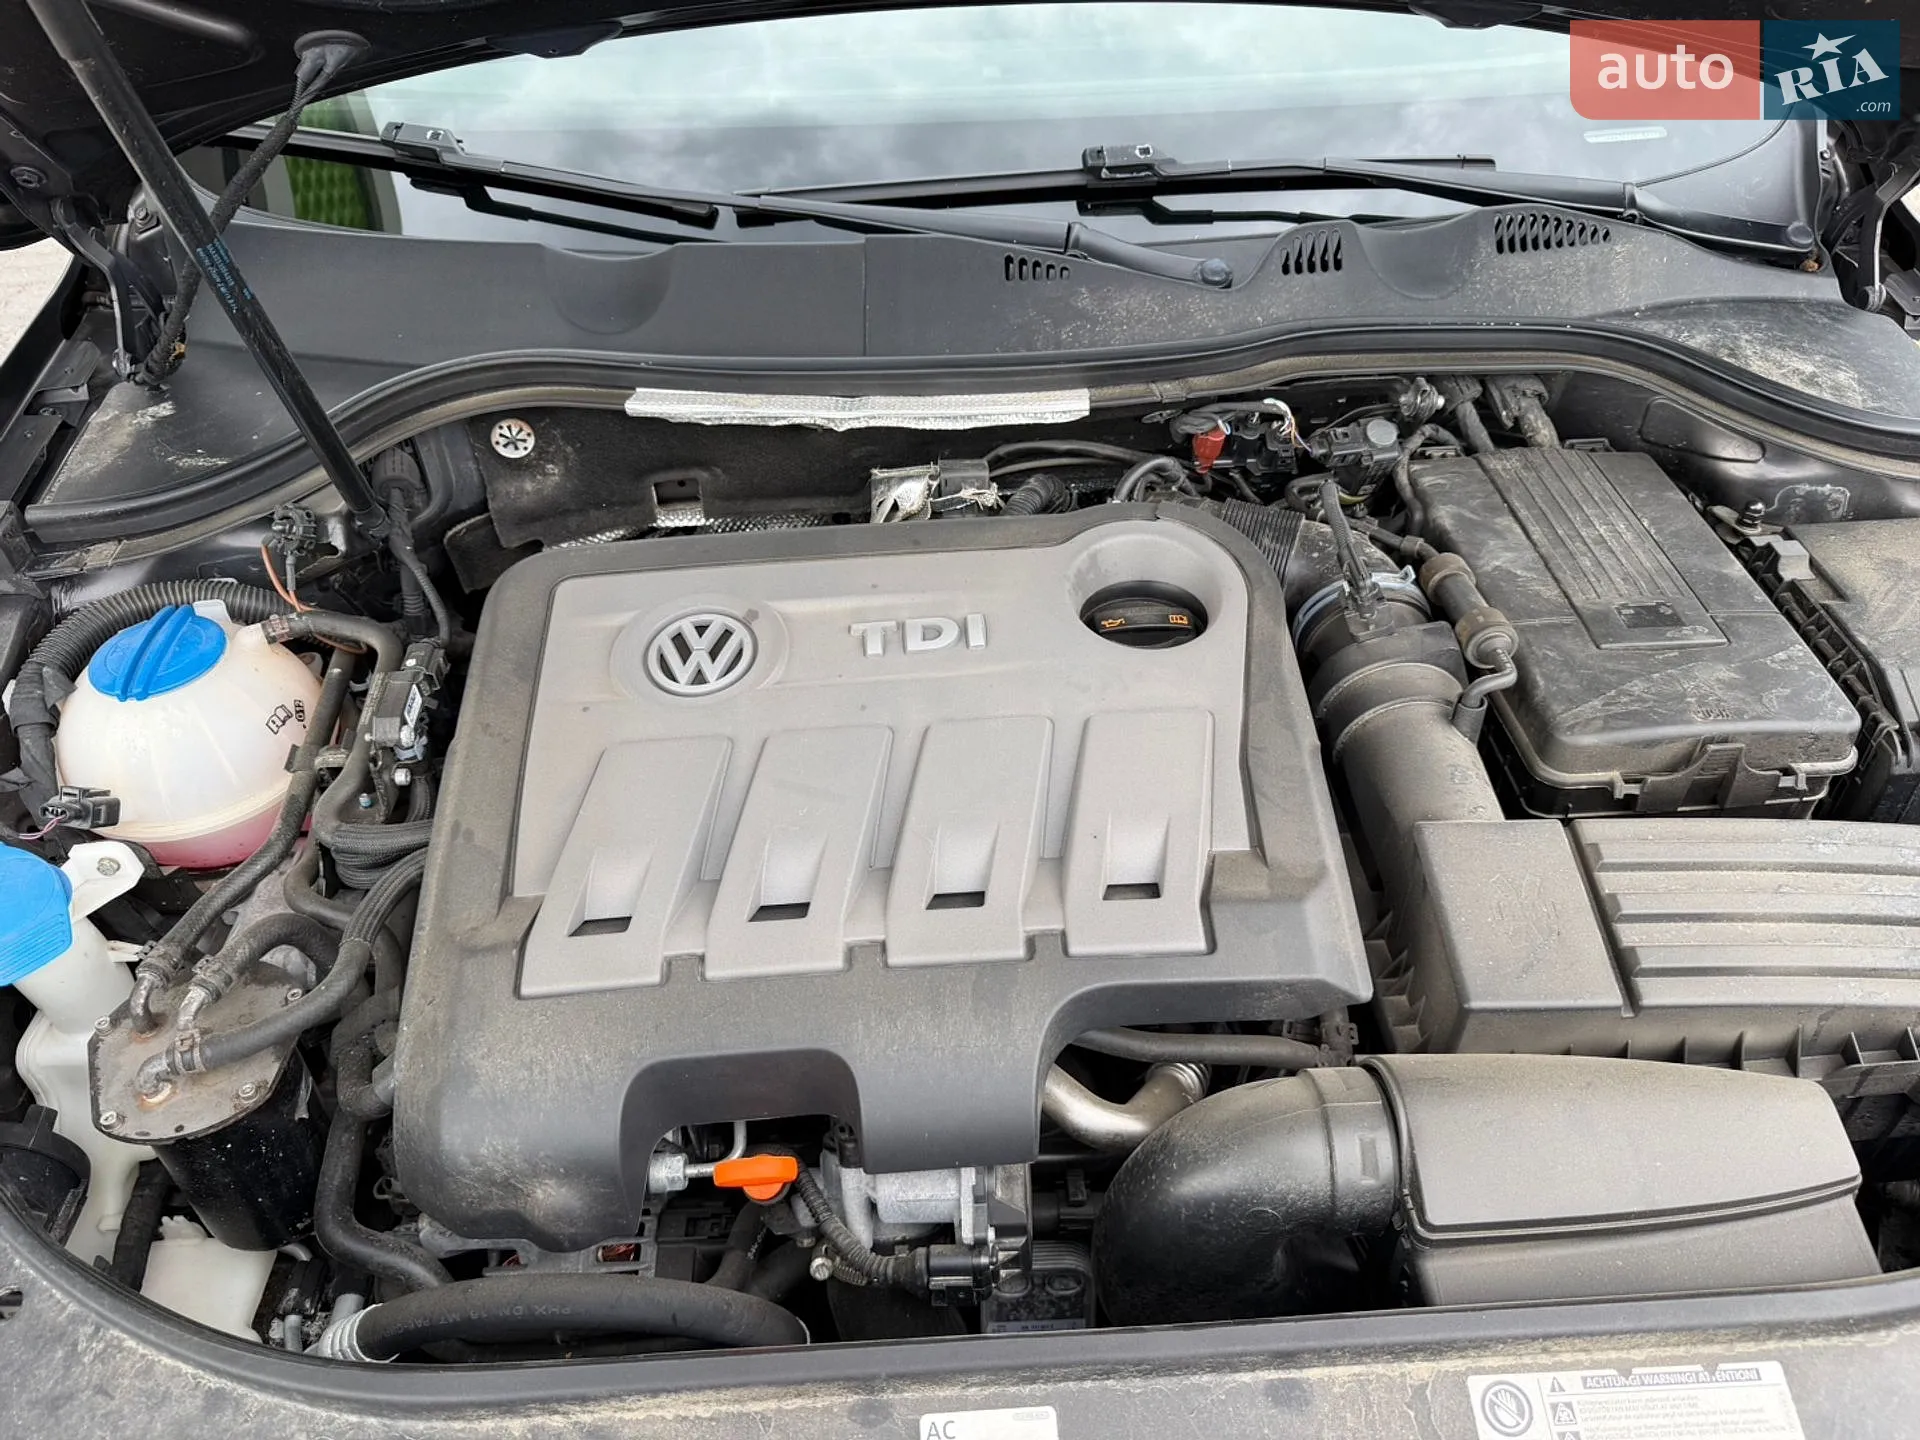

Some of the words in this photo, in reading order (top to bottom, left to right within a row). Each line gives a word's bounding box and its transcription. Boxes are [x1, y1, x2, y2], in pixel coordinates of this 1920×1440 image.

[849, 613, 987, 657] TDI
[648, 613, 755, 695] VW
[1642, 1372, 1697, 1386] WARNING!
[927, 1420, 956, 1440] AC
